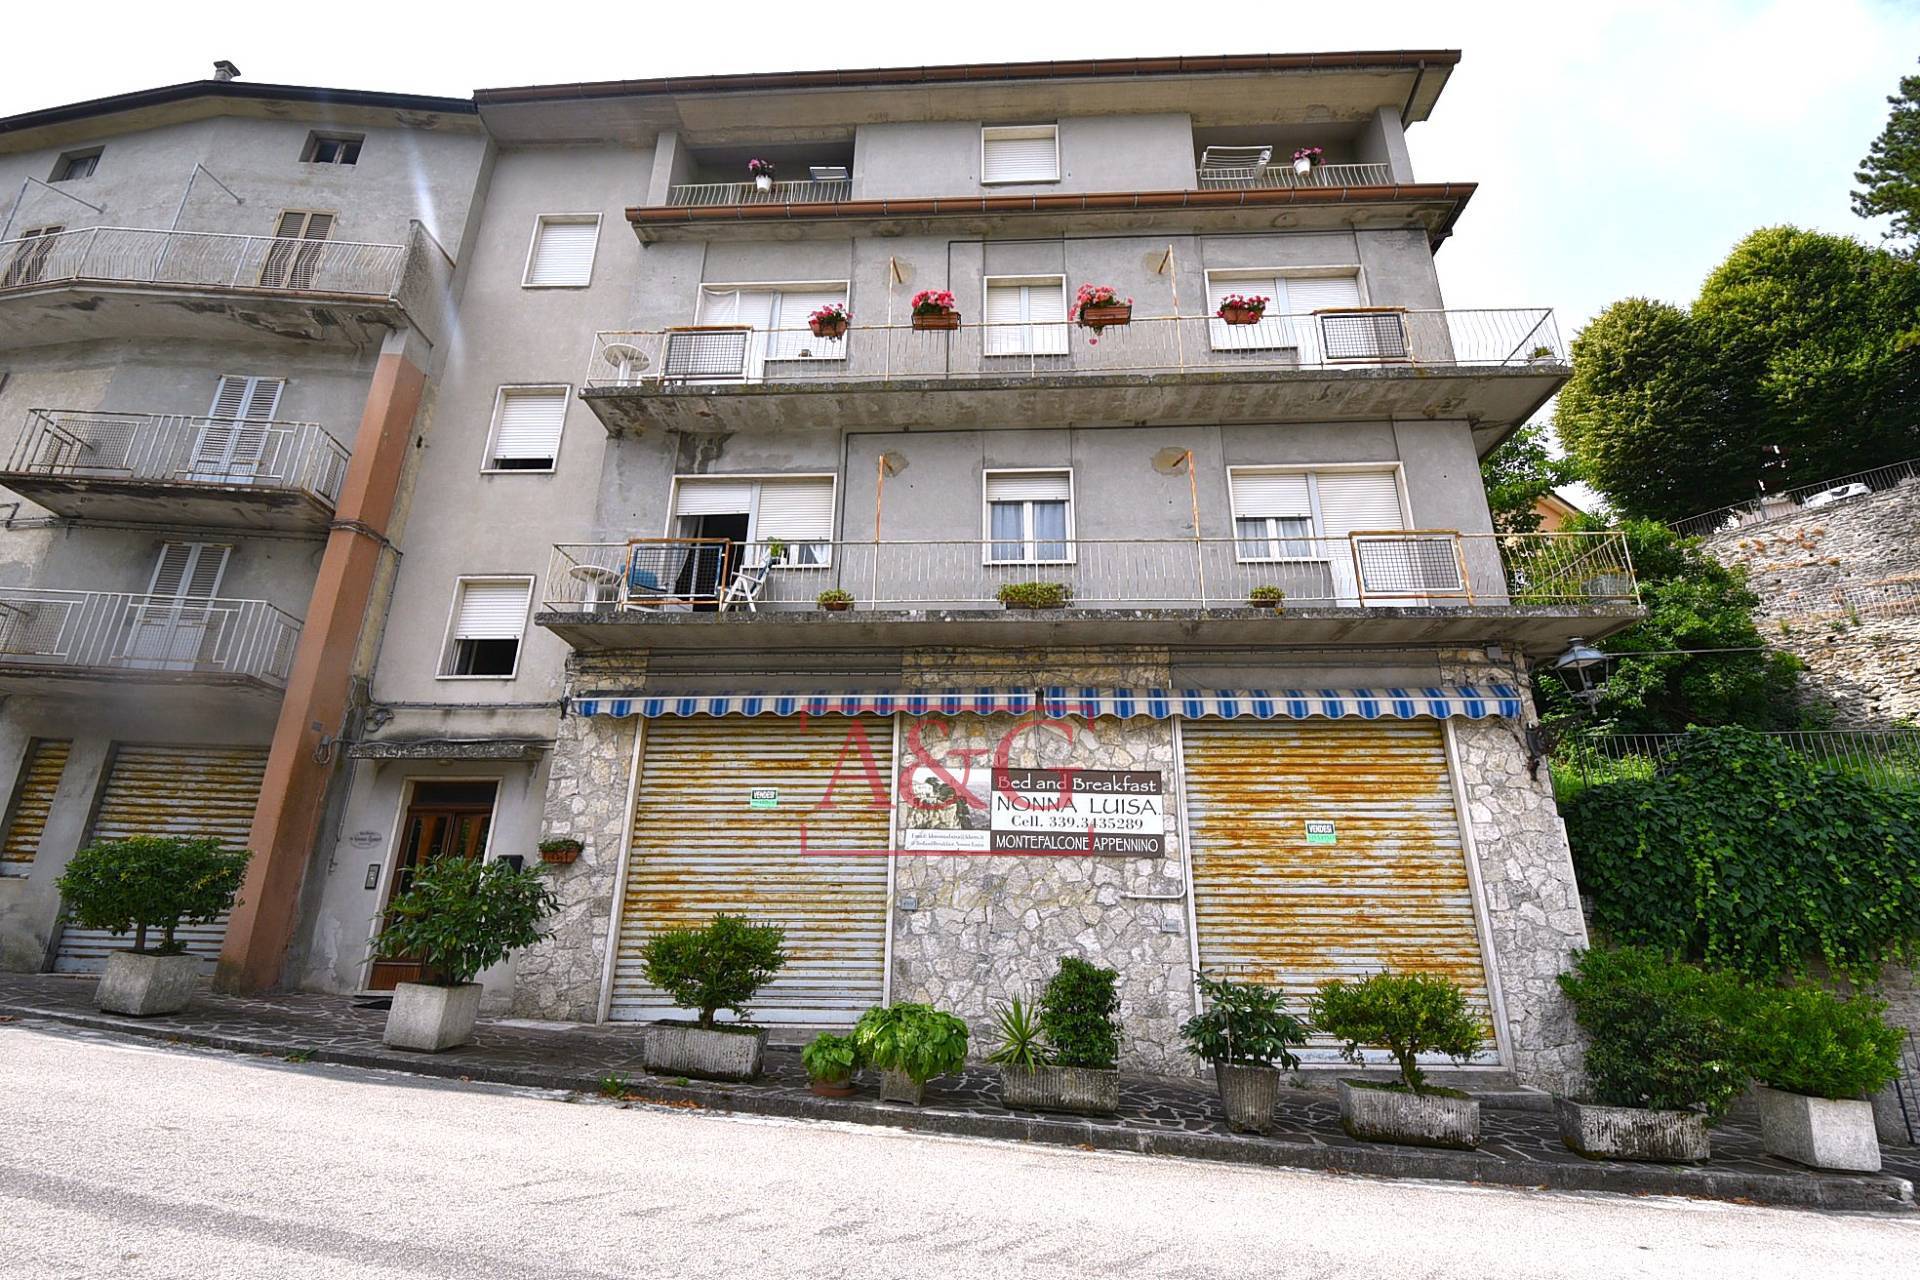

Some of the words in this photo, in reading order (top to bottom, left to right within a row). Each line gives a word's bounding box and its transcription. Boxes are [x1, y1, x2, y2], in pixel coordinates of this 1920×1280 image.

[998, 772, 1031, 789] Bed
[1036, 773, 1066, 790] and
[1072, 774, 1157, 792] Breakfast
[997, 795, 1077, 813] NONNA
[1011, 815, 1043, 827] Cell.
[1308, 824, 1332, 833] VENDESI
[996, 834, 1089, 851] MONTEFALCONE
[1093, 837, 1159, 852] APPENNINO
